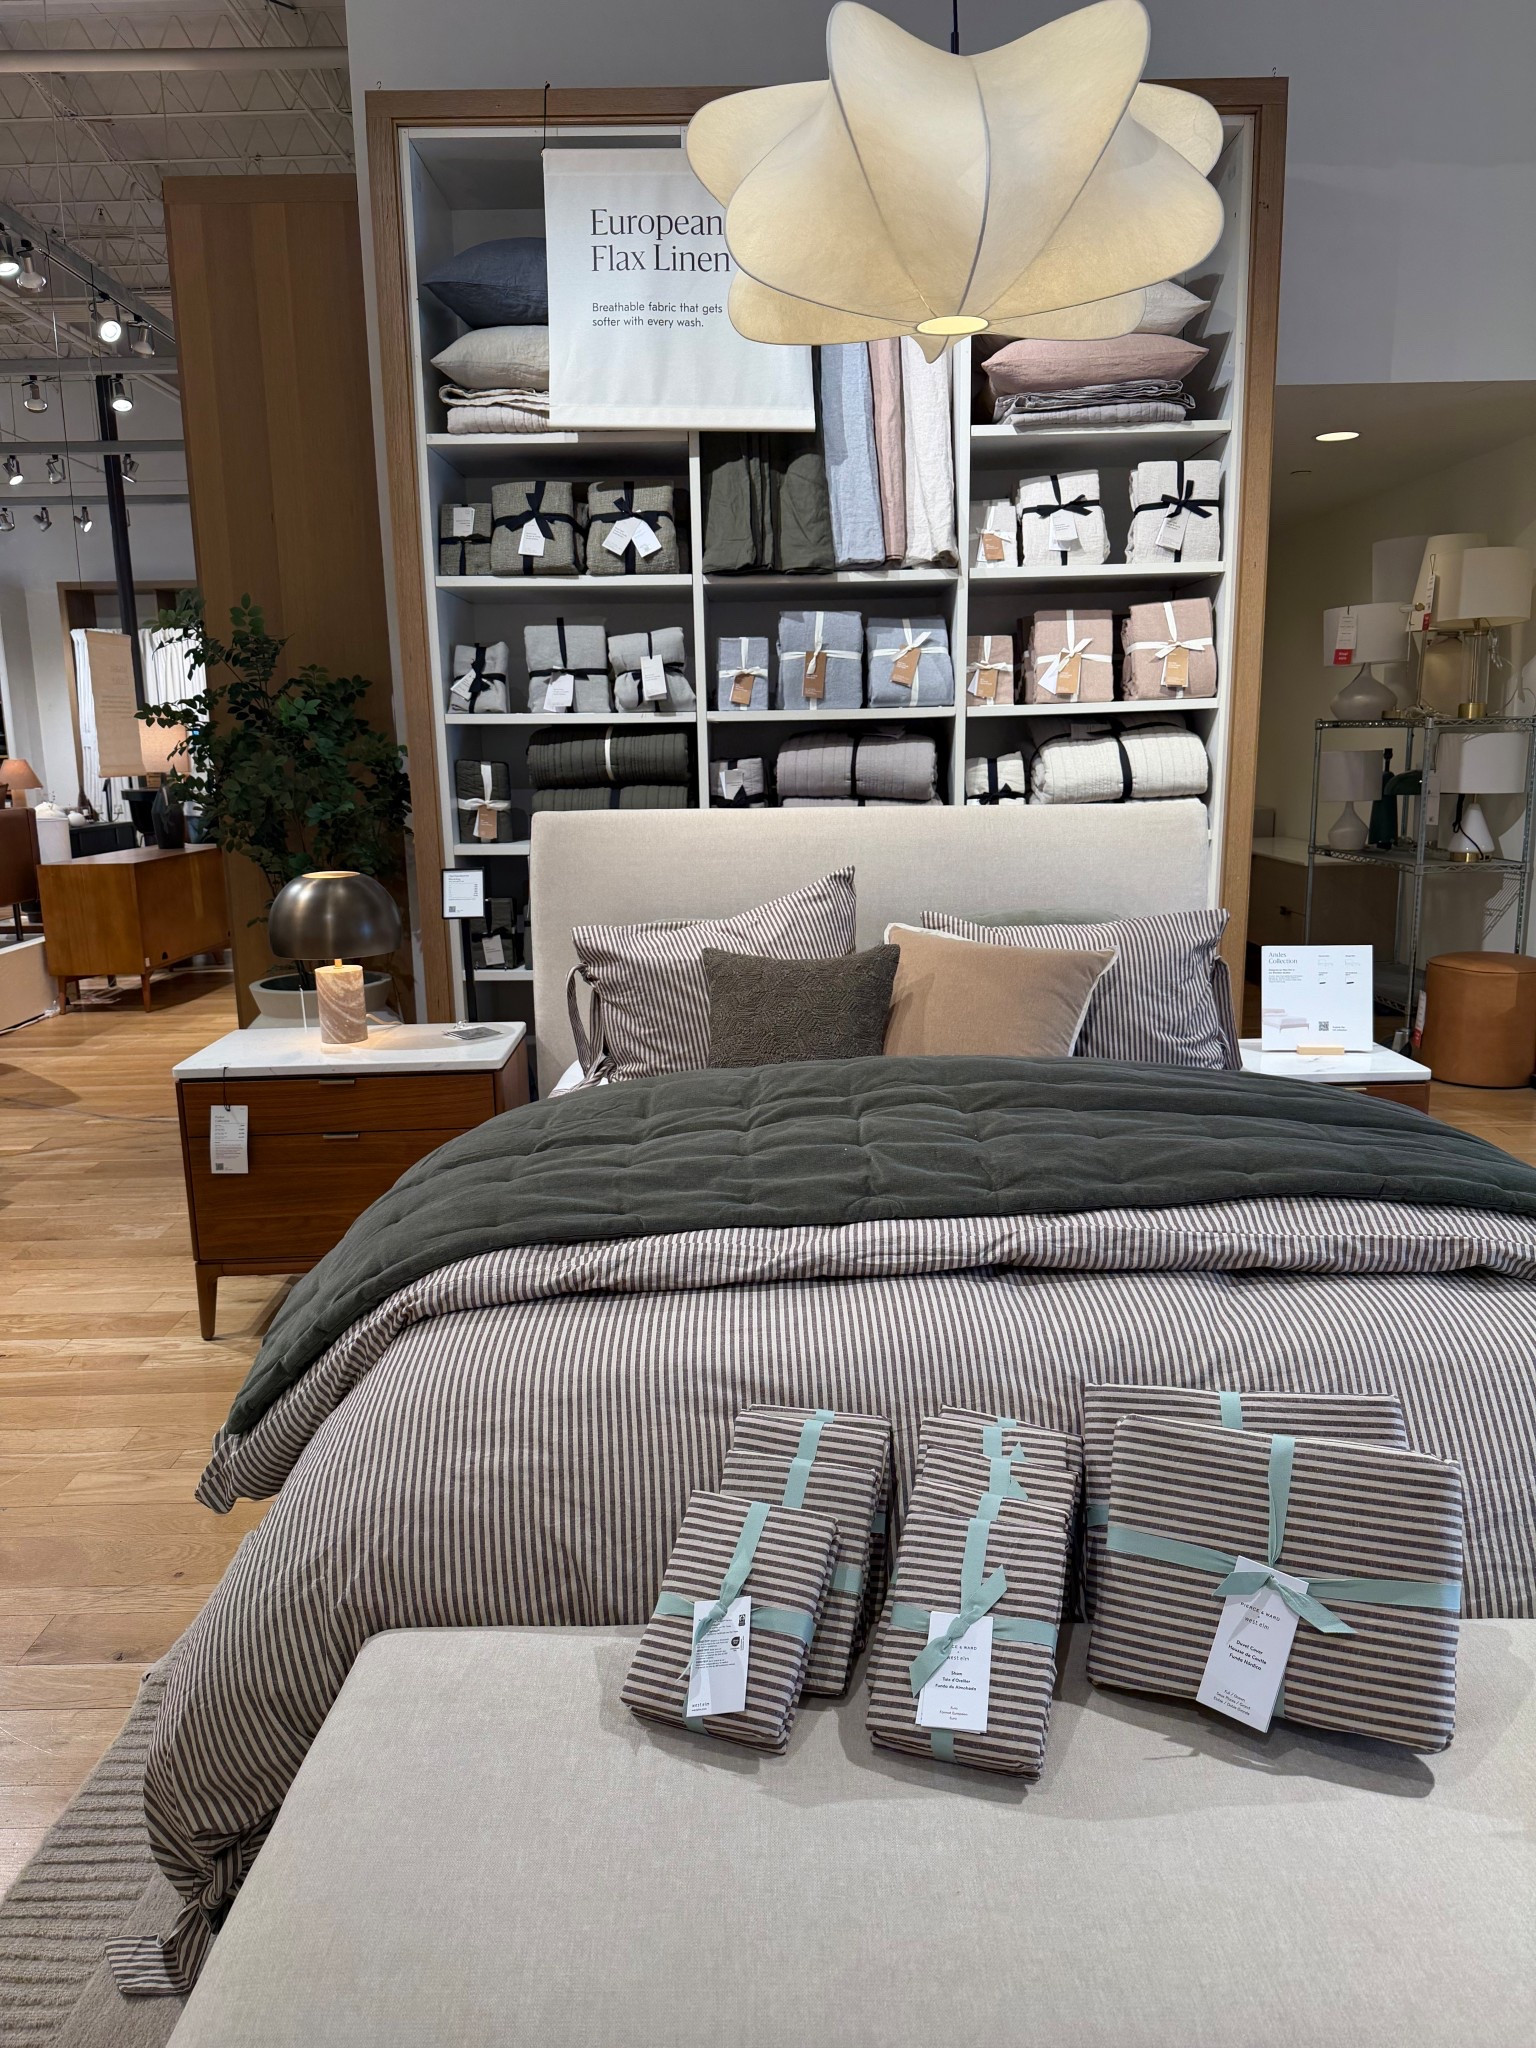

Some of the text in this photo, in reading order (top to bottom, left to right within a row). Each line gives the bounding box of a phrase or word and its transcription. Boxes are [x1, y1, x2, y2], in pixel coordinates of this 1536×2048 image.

[590, 208, 724, 240] European
[591, 244, 731, 272] Flax Linen
[592, 302, 723, 315] Breathable fabric that gets
[592, 316, 704, 329] softer with every wash.
[1240, 1602, 1260, 1613] PIERCE
[1265, 1612, 1281, 1622] WARD
[1244, 1617, 1270, 1630] west elm
[1236, 1640, 1263, 1655] Duvet Cover
[1229, 1653, 1243, 1662] Funda
